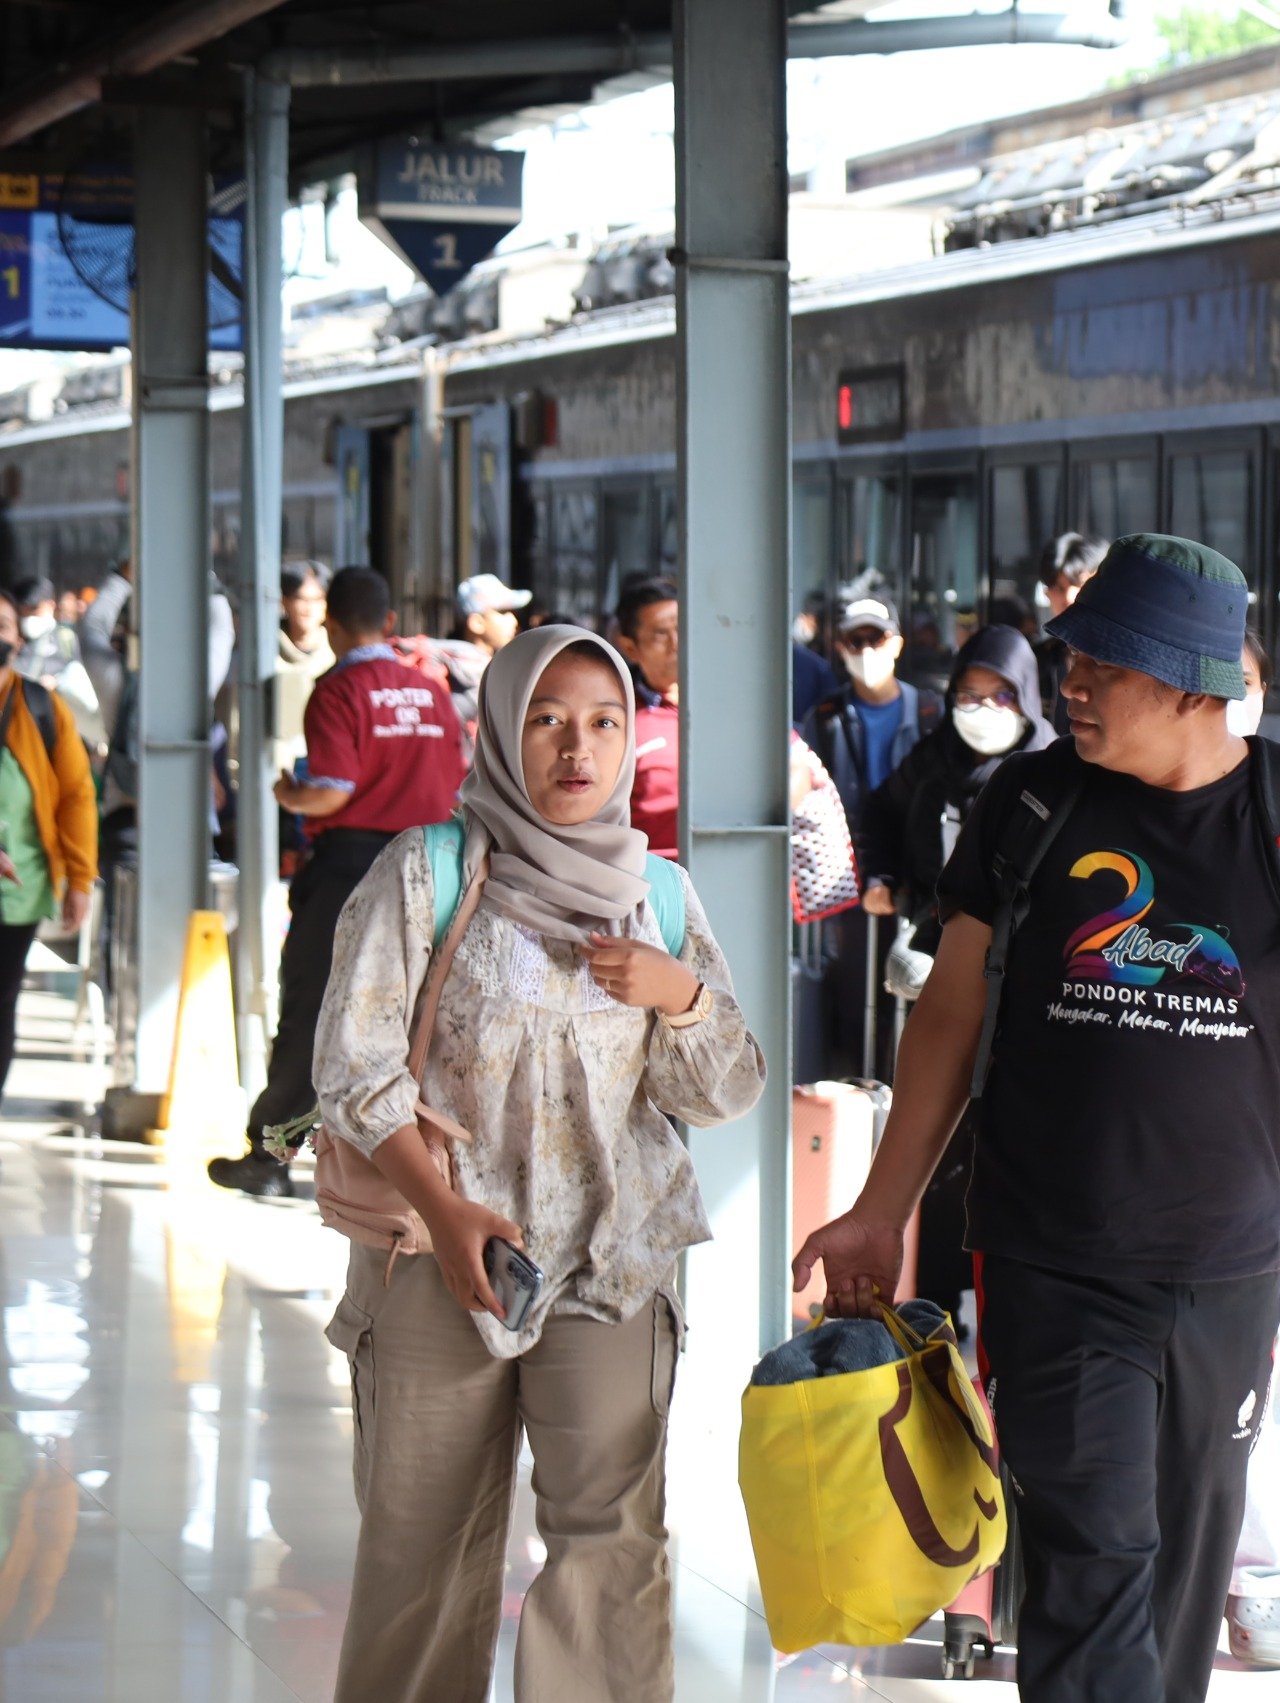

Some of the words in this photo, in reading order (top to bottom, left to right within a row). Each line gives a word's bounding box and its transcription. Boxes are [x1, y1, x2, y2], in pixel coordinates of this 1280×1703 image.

[399, 153, 504, 186] JALUR
[433, 233, 461, 268] 1
[369, 687, 433, 709] PORTER
[1062, 848, 1166, 985] 2
[1102, 925, 1203, 972] Abad
[1062, 982, 1147, 1005] PONDOK
[1153, 992, 1239, 1014] TREMAS
